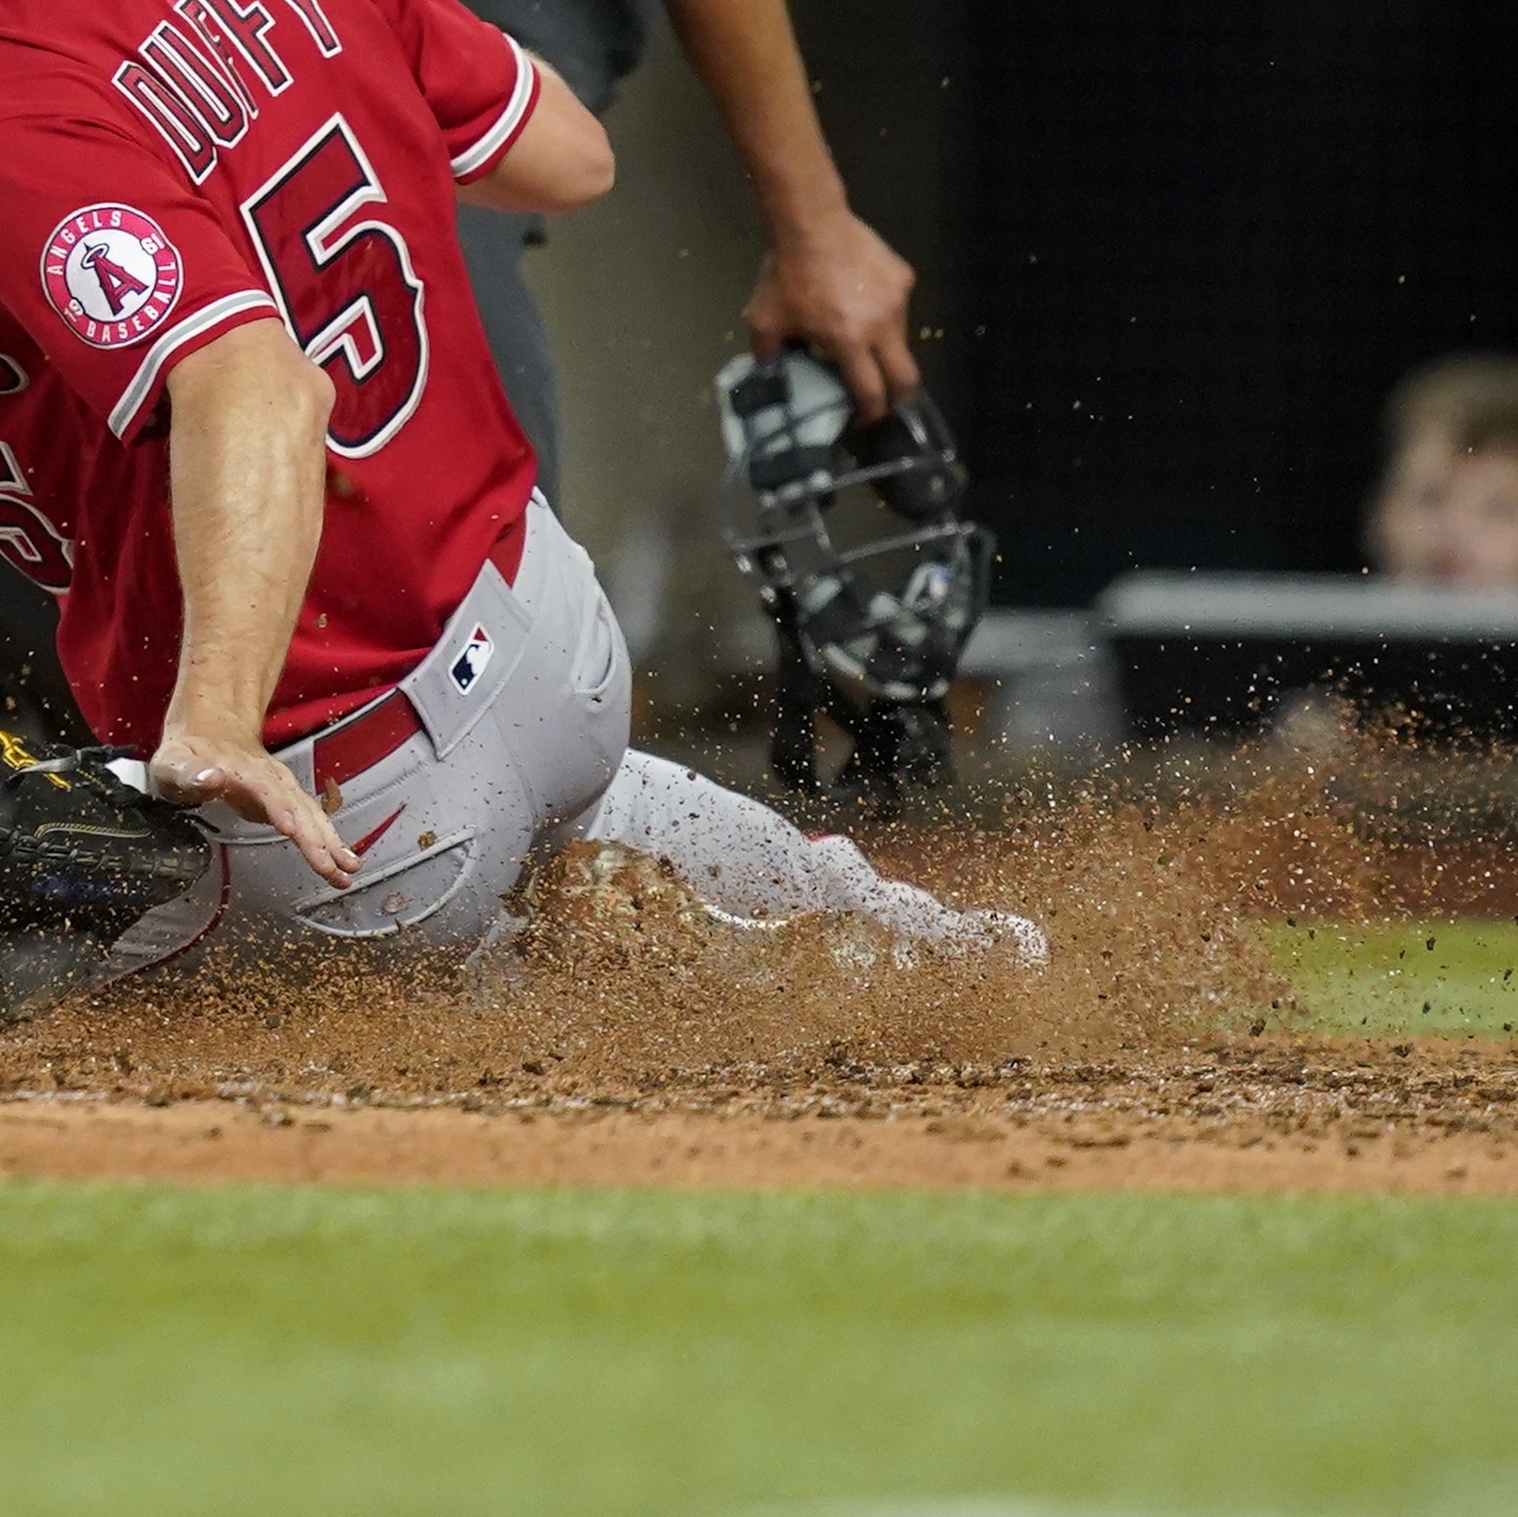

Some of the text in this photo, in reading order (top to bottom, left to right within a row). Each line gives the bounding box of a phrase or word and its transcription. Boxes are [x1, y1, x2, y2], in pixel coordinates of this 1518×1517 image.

[46, 210, 122, 276] ANGELS
[80, 241, 150, 317] A
[141, 232, 165, 256] 61
[86, 261, 178, 343] BASEBALL
[239, 111, 430, 460] 5
